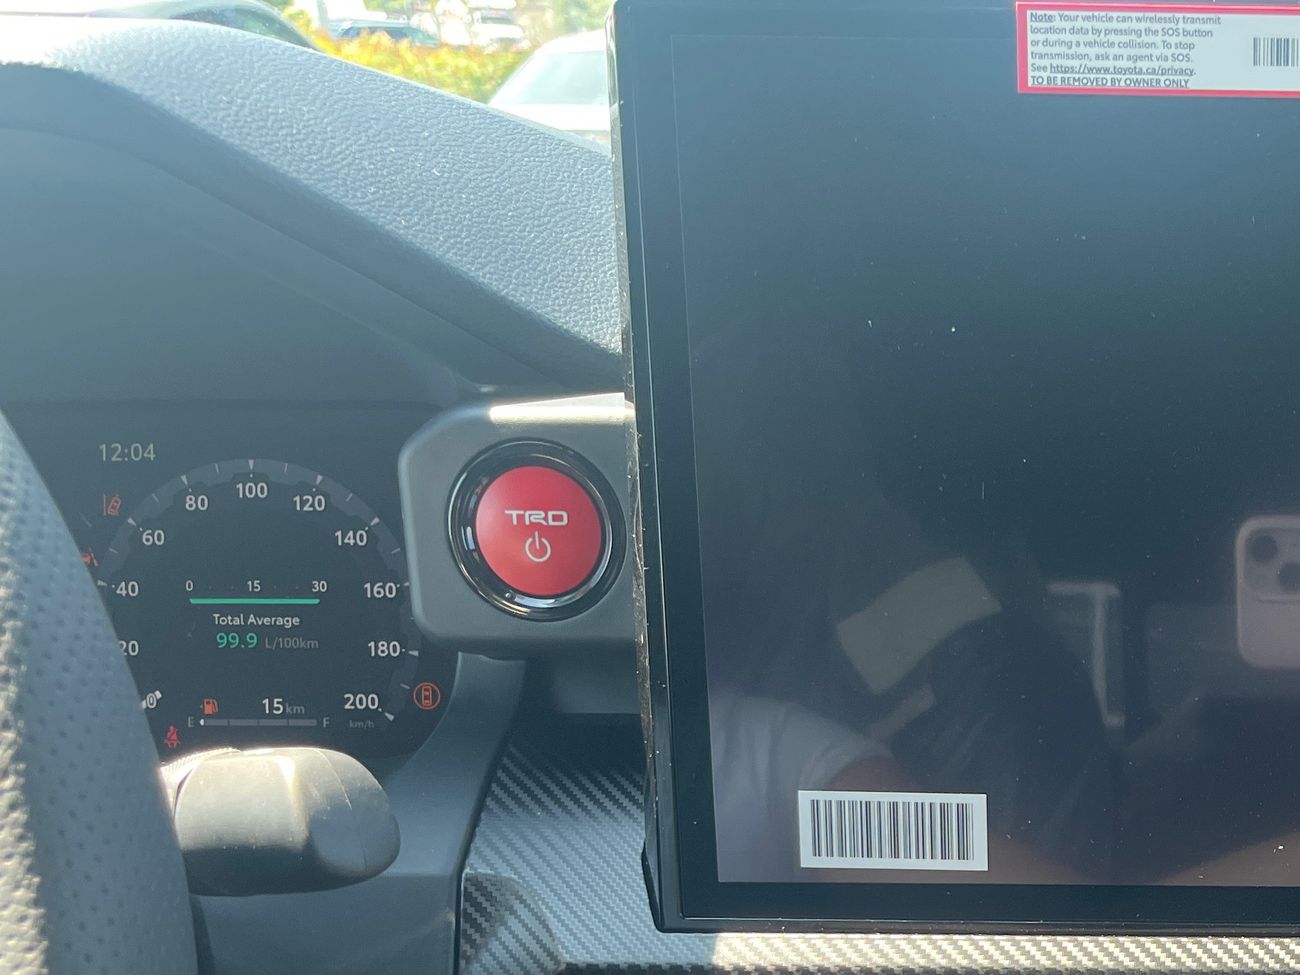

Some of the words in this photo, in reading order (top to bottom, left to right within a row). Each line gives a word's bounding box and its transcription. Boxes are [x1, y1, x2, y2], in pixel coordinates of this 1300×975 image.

[1030, 12, 1056, 23] Note:
[1058, 13, 1079, 22] Your
[1081, 13, 1114, 22] vehicle
[1116, 15, 1133, 23] can
[1135, 14, 1180, 26] wirelessly
[1182, 16, 1221, 24] transmit
[1030, 26, 1066, 34] location
[1069, 26, 1089, 35] data
[1092, 26, 1103, 37] by
[1104, 28, 1142, 38] pressing
[1144, 27, 1159, 36] the
[1162, 28, 1180, 36] SOS
[1182, 28, 1213, 37] button
[1042, 38, 1072, 49] during
[1082, 39, 1116, 48] vehicle
[1118, 39, 1158, 48] collision.
[1162, 40, 1172, 49] To
[1174, 42, 1194, 51] stop
[1031, 52, 1092, 61] transmission,
[1094, 52, 1110, 60] ask
[1126, 54, 1154, 64] agent
[1156, 53, 1168, 62] via
[1171, 54, 1192, 62] SOS.
[1031, 63, 1048, 72] See
[1050, 63, 1196, 76] https://www.toyota.ca/privacy.
[1030, 76, 1044, 86] TO
[1046, 77, 1058, 86] BE
[1060, 77, 1108, 86] REMOVED
[1110, 77, 1122, 86] BY
[1124, 78, 1160, 88] OWNER
[1164, 78, 1190, 88] ONLY
[99, 443, 156, 462] 12:04
[236, 483, 268, 498] 100
[185, 496, 208, 511] 80
[294, 496, 325, 511] 120
[504, 510, 568, 526] TRD
[142, 530, 164, 546] 60
[335, 530, 368, 546] 140
[116, 581, 138, 597] 40
[186, 581, 194, 592] 0
[248, 580, 260, 592] 15
[312, 581, 327, 592] 30
[364, 582, 396, 598] 160
[213, 614, 244, 626] Total
[248, 614, 300, 628] Average
[216, 633, 258, 648] 99.9
[265, 636, 319, 650] L/100km
[368, 642, 400, 656] 180
[262, 698, 283, 714] 15
[286, 703, 304, 714] km
[344, 694, 378, 709] 200
[188, 718, 194, 728] E
[323, 718, 329, 728] F
[349, 719, 374, 729] km/h
